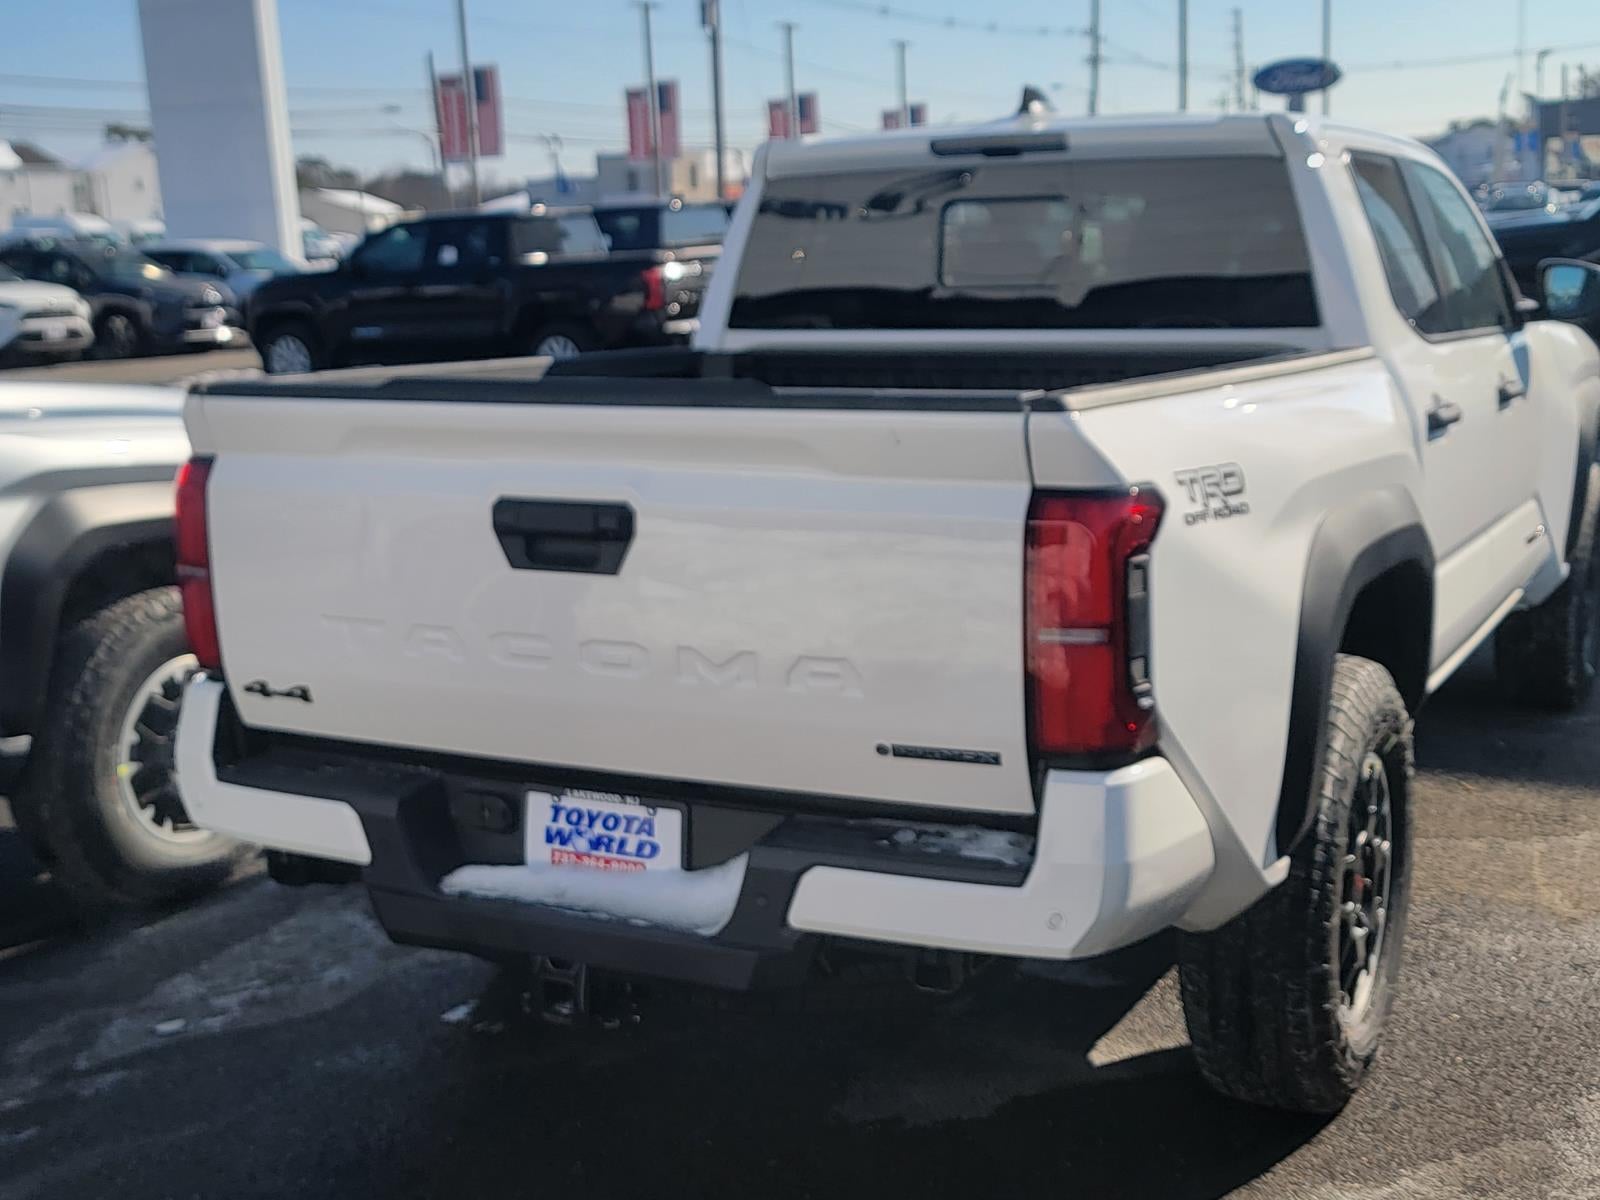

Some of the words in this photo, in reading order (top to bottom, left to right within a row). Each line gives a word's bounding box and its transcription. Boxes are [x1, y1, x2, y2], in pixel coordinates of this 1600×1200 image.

[1173, 462, 1246, 508] TRD
[1184, 510, 1208, 526] OFF
[320, 613, 865, 698] TACOMA
[551, 804, 655, 838] TOYOTA
[545, 825, 660, 859] WORLD
